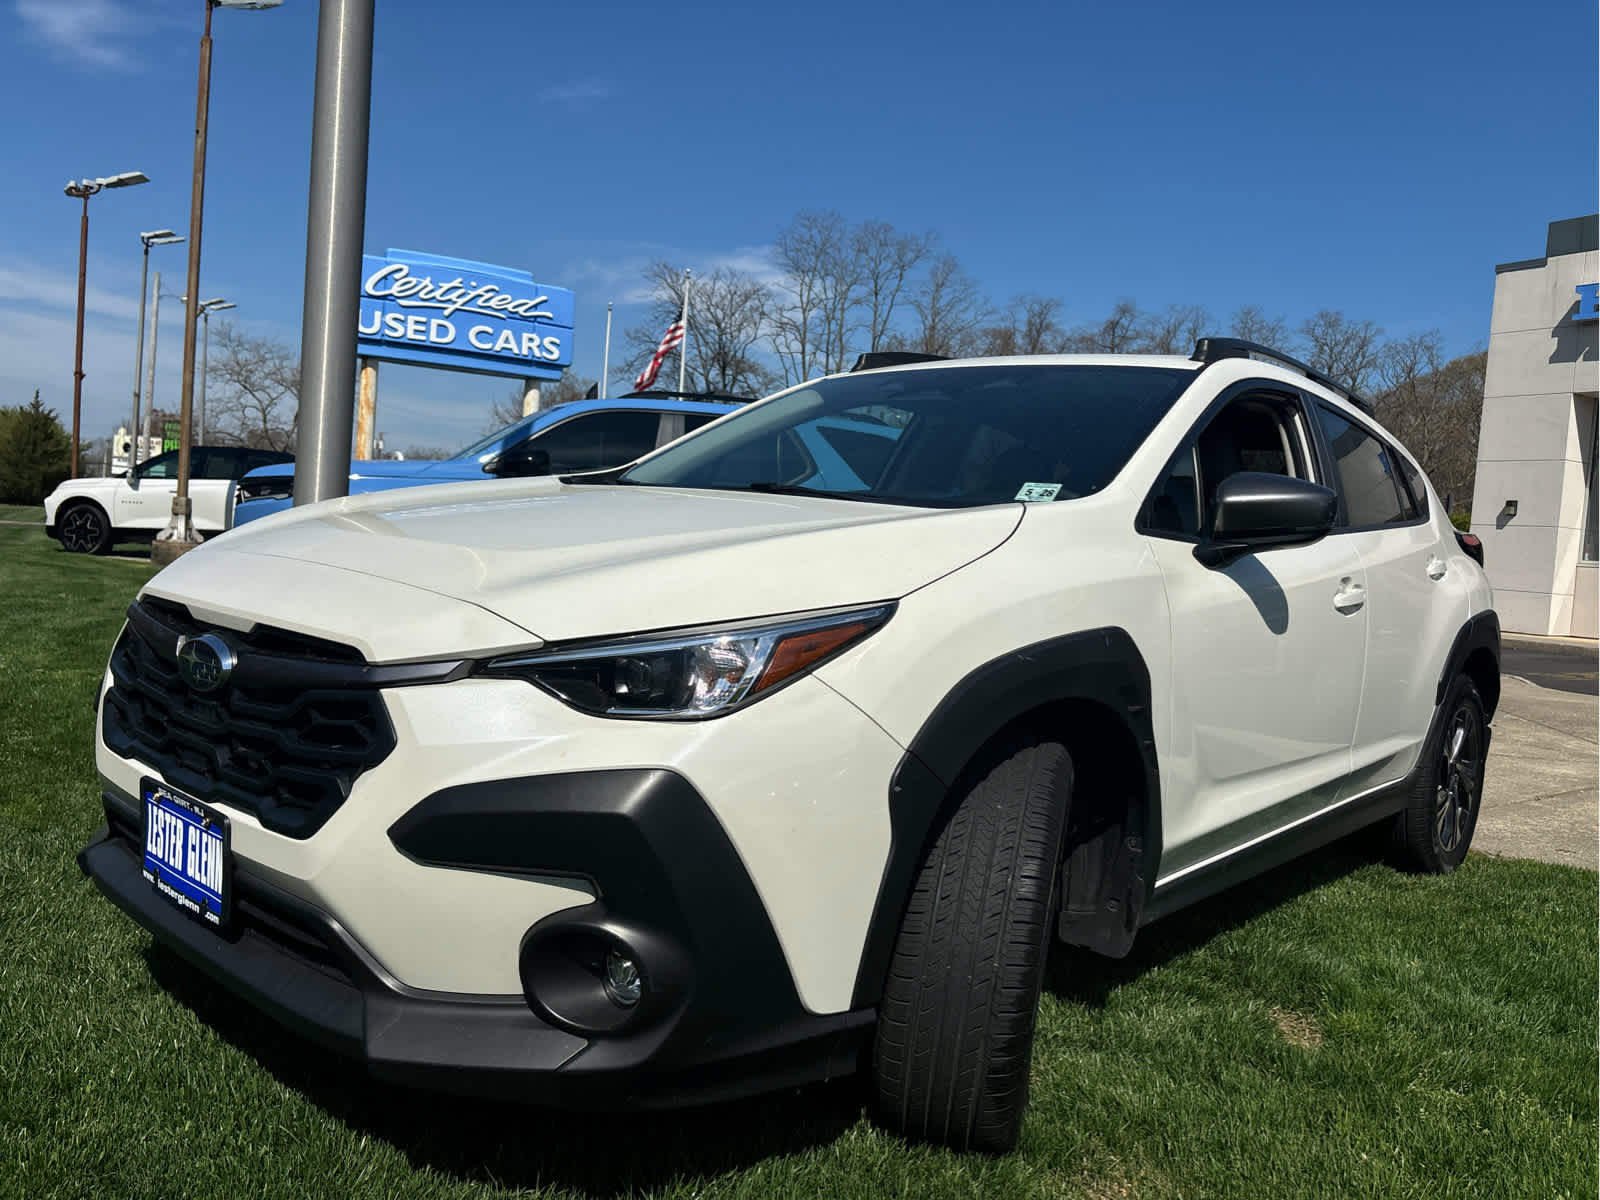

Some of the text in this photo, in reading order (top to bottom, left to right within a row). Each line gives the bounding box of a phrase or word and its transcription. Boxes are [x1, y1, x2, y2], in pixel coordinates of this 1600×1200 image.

[365, 264, 553, 319] Certified
[358, 309, 561, 361] USED CARS
[147, 802, 223, 895] LESTER GLENN
